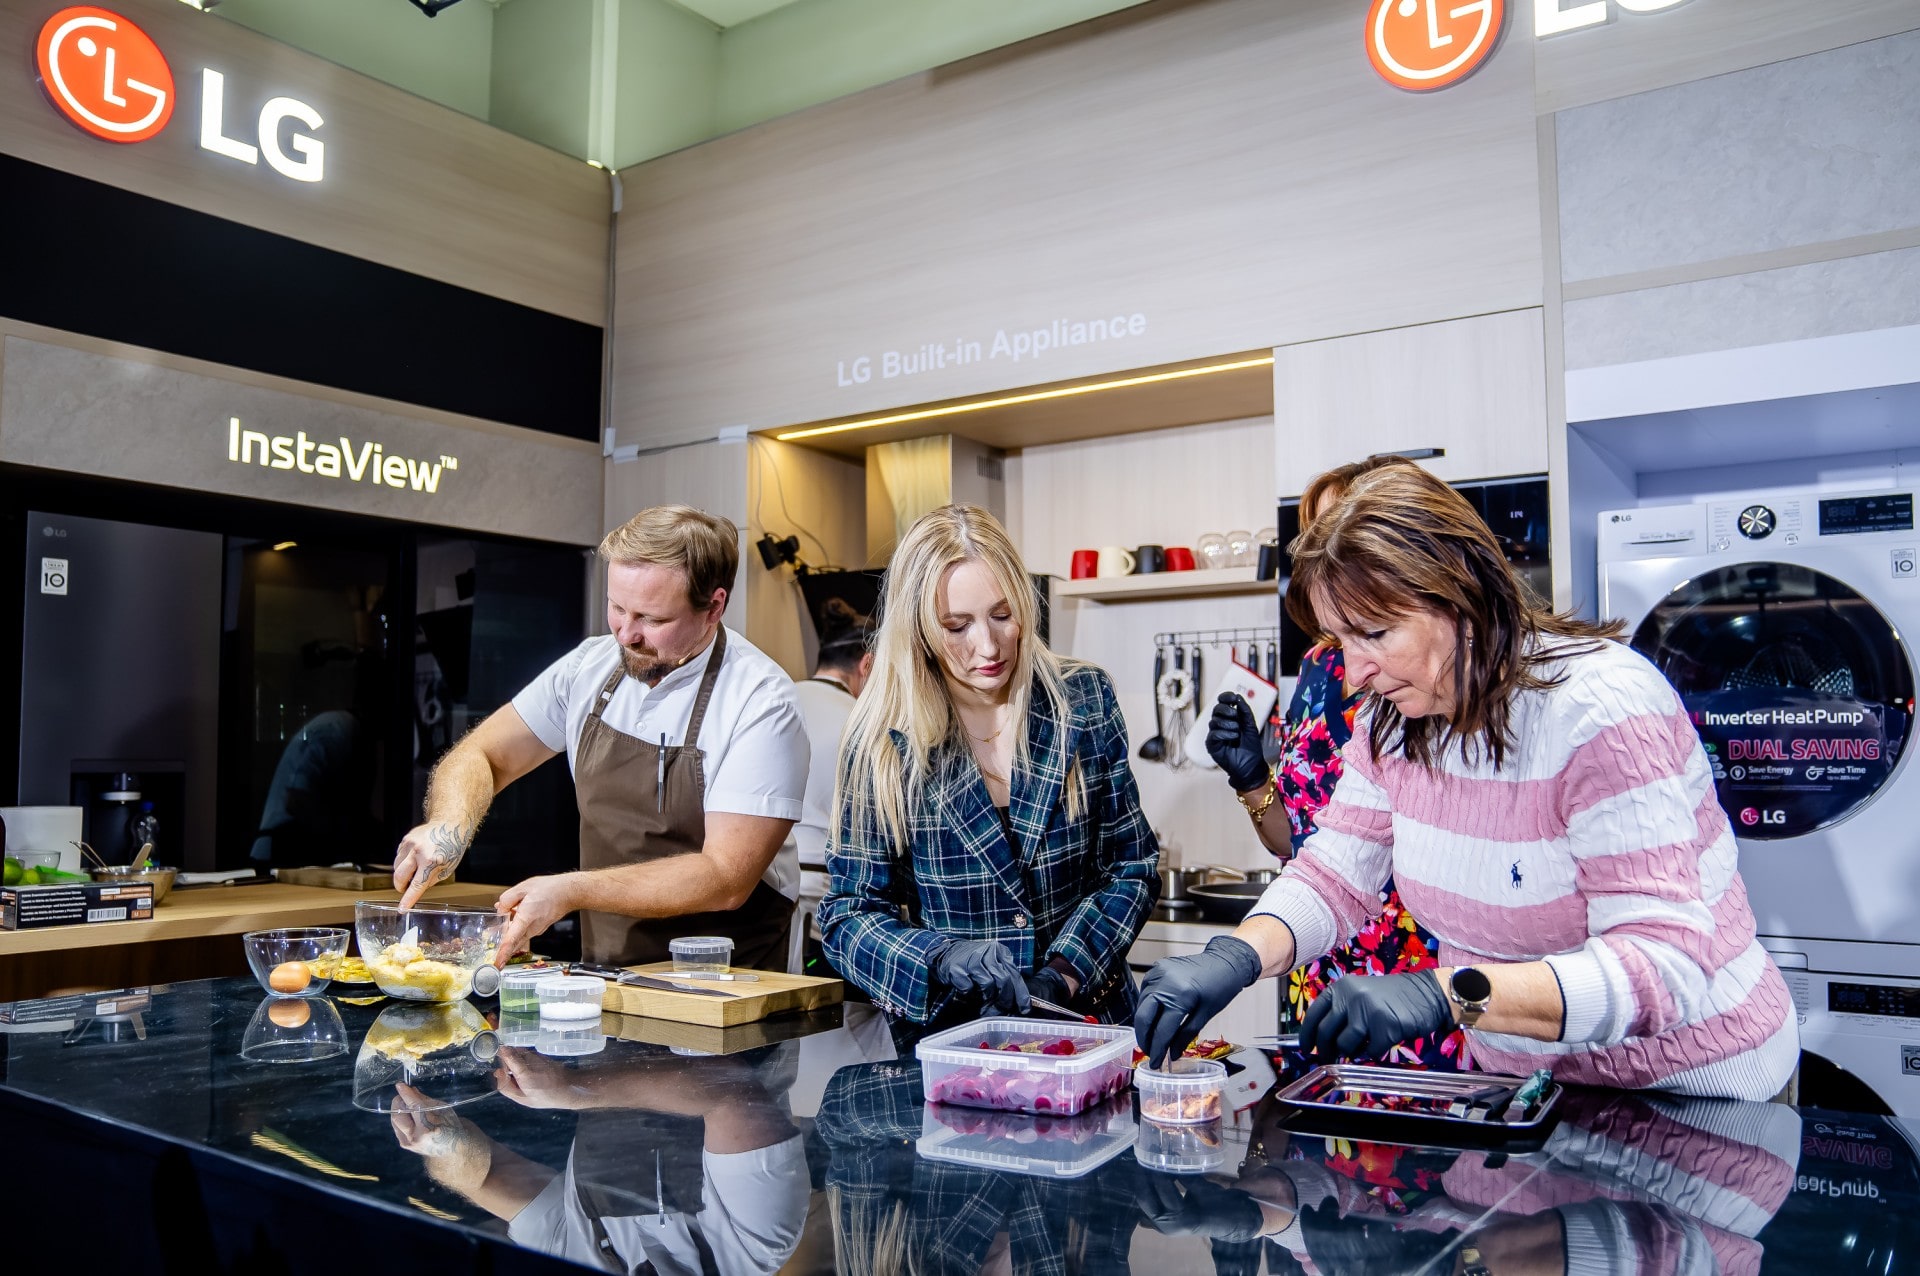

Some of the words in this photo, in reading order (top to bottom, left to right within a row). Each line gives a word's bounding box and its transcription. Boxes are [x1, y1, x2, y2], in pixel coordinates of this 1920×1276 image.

[200, 67, 325, 183] LG
[837, 357, 872, 388] LG
[881, 337, 982, 380] Built-in
[989, 312, 1147, 362] Appliance
[1621, 514, 1632, 522] LG
[54, 529, 67, 538] LG
[1705, 710, 1769, 726] Inverter
[1728, 740, 1789, 761] DUAL
[1791, 739, 1880, 761] SAVING
[1748, 766, 1766, 774] Save
[1767, 766, 1794, 776] Energy
[1827, 766, 1845, 774] Save
[1847, 766, 1867, 774] Time
[1763, 810, 1786, 824] LG
